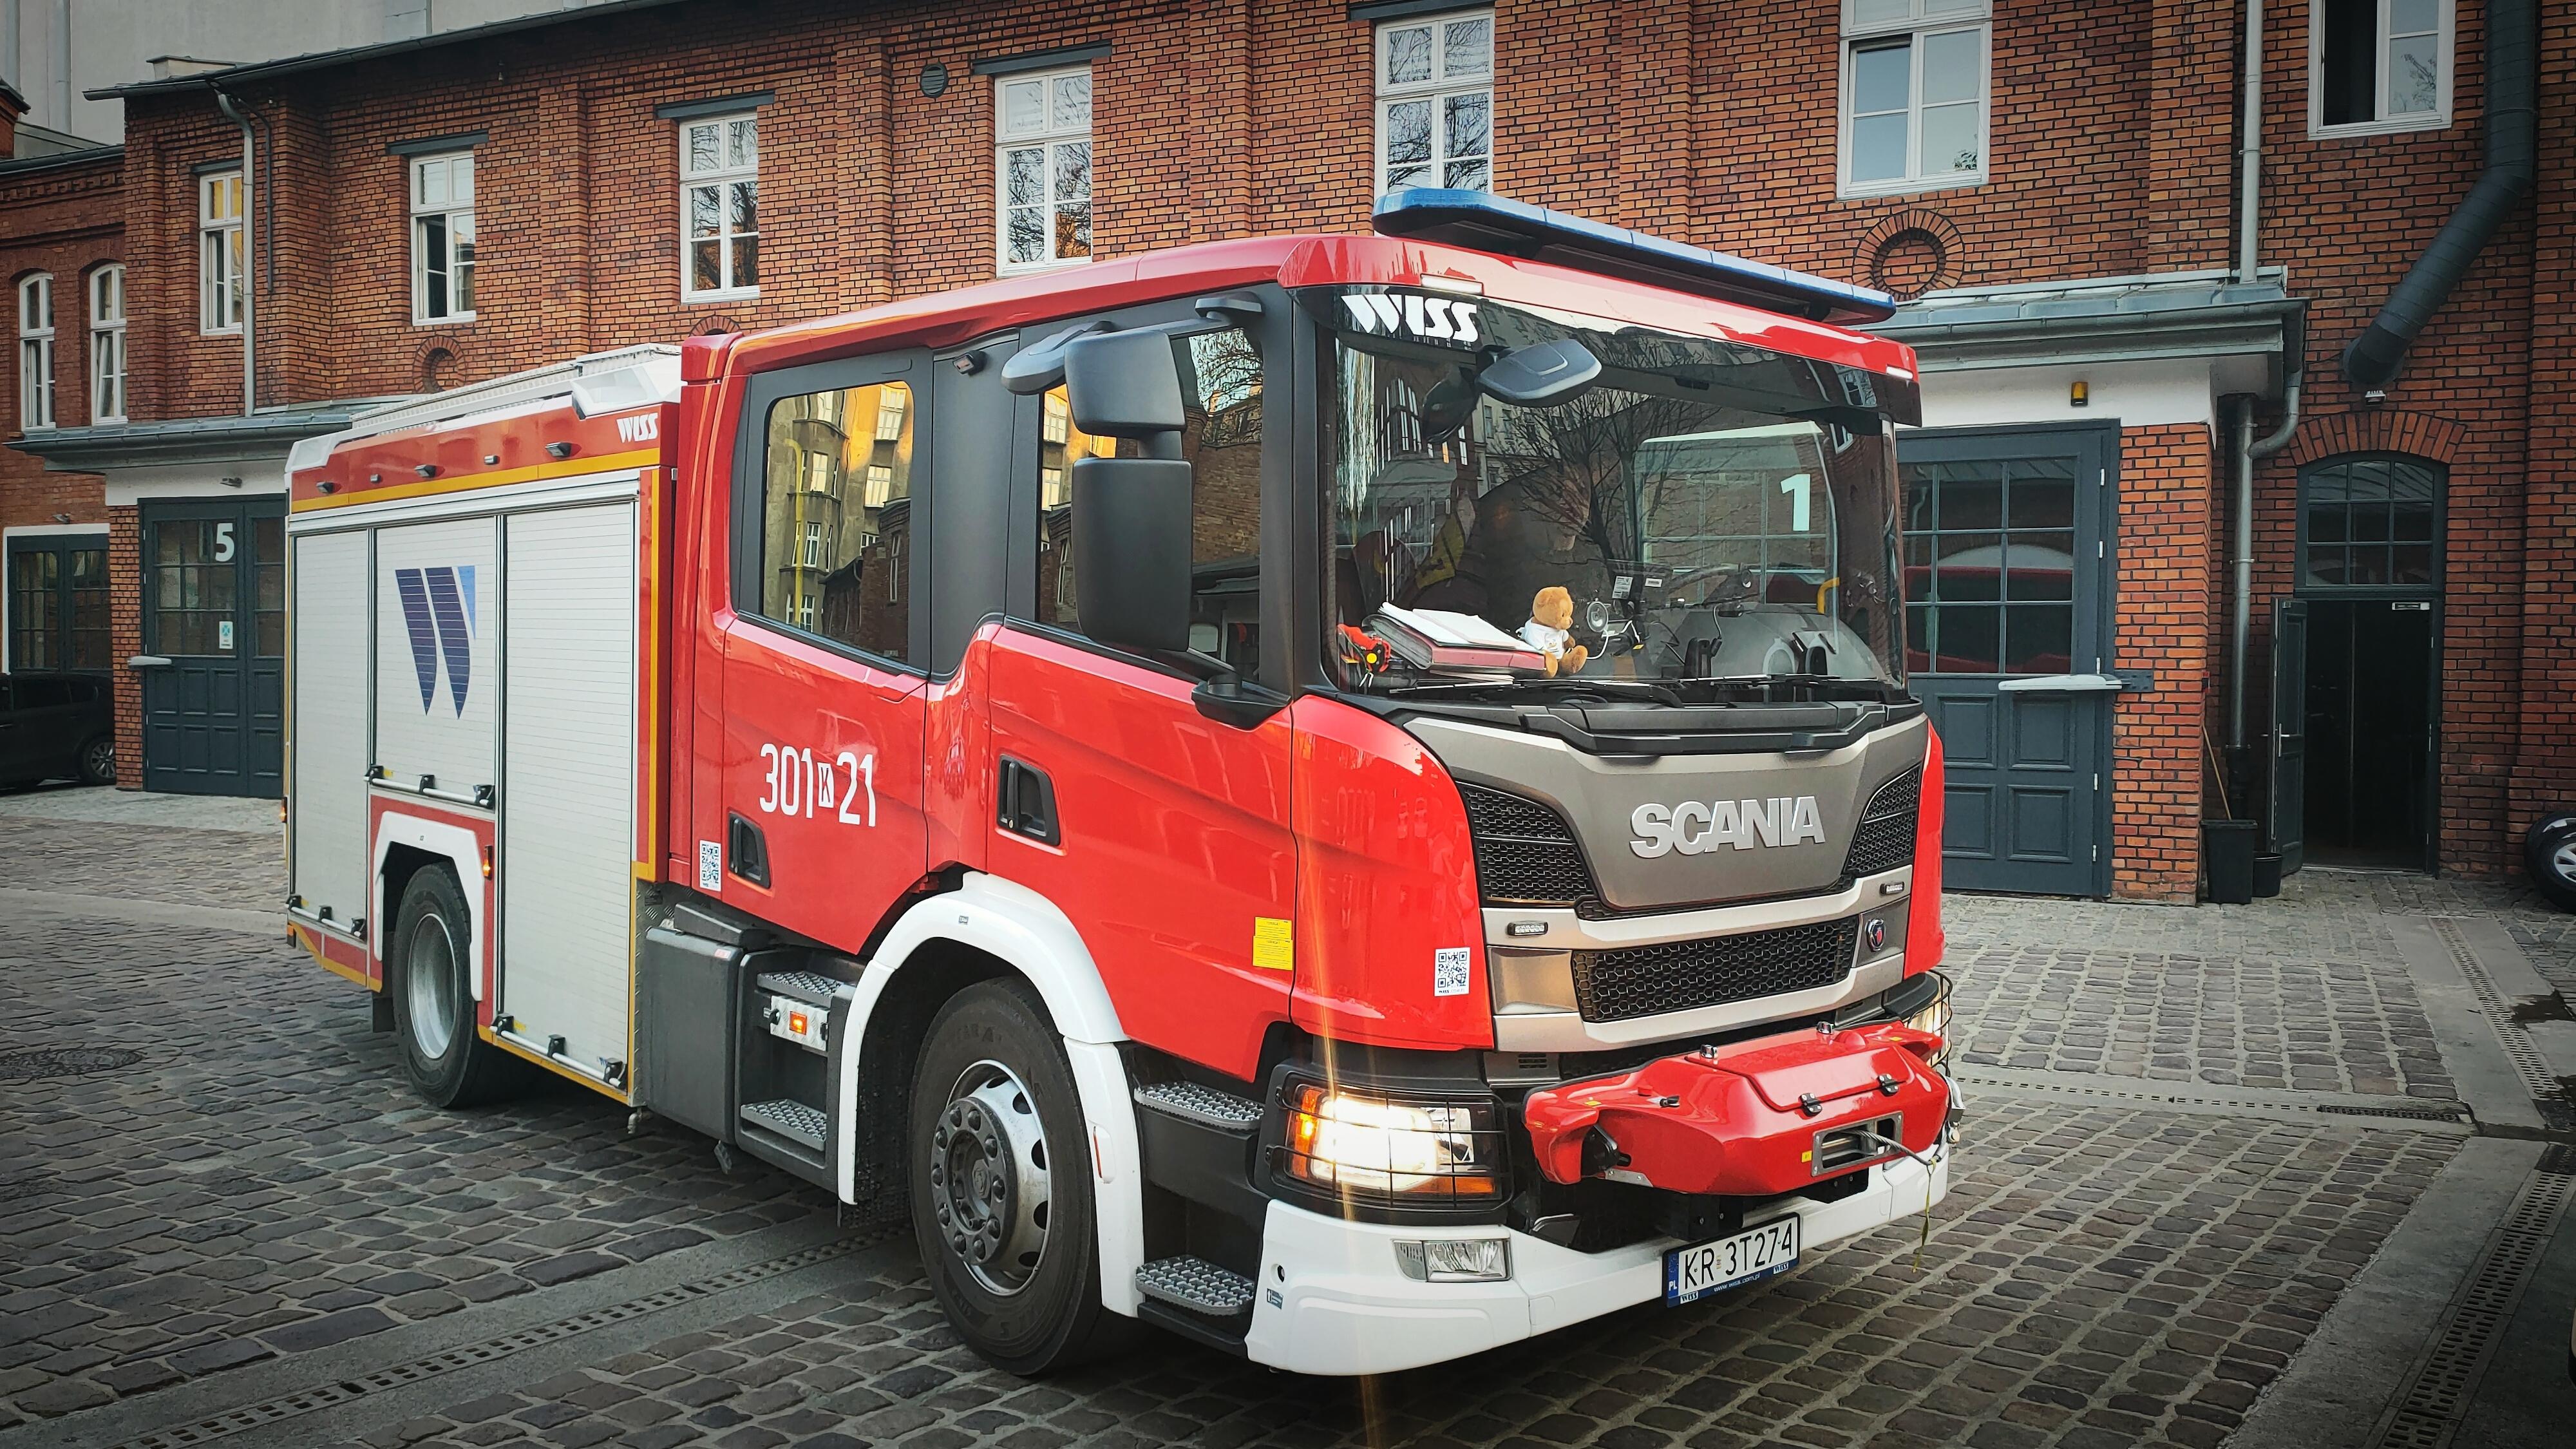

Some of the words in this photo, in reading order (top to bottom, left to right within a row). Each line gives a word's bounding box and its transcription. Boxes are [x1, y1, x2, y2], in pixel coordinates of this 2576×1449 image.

[1341, 294, 1479, 343] WISS
[616, 412, 658, 443] WISS
[1781, 474, 1810, 531] 1
[215, 523, 234, 562] 5
[759, 744, 813, 819] 301
[837, 752, 876, 827] 21
[1630, 795, 1826, 858] SCANIA
[1685, 1248, 1714, 1289] KR
[1725, 1222, 1792, 1276] 3T274
[1669, 1280, 1678, 1291] PL
